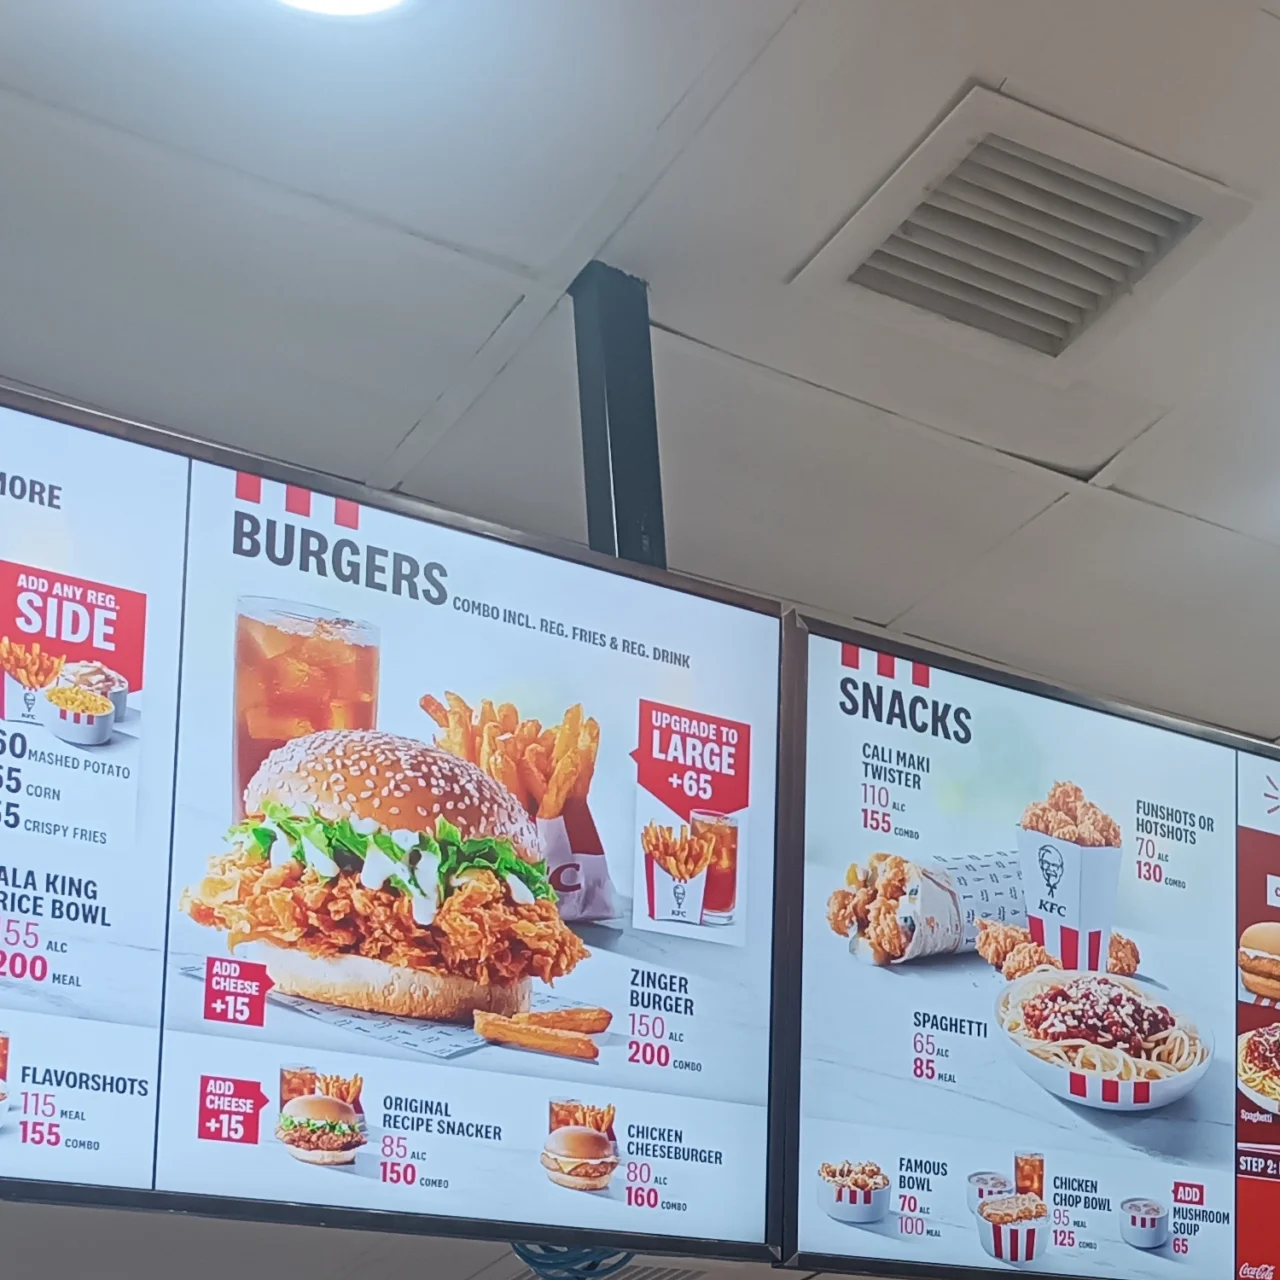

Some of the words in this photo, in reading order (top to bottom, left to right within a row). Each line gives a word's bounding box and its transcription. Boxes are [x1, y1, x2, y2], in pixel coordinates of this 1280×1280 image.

[17, 574, 49, 593] ADD
[52, 581, 83, 601] ANY
[87, 591, 120, 611] REG.
[232, 510, 449, 606] BURGERS
[453, 596, 500, 620] COMBO
[503, 608, 536, 630] INCL.
[540, 618, 569, 638] REG.
[572, 626, 606, 648] FRIES
[609, 636, 619, 651] &
[622, 639, 650, 659] REG.
[653, 647, 691, 669] DRINK
[15, 591, 116, 652] SIDE
[839, 676, 972, 744] SNACKS
[652, 709, 717, 740] UPGRADE
[720, 726, 738, 745] TO
[28, 748, 80, 770] MASHED
[84, 759, 131, 779] POTATO
[652, 729, 736, 776] LARGE
[862, 742, 892, 764] CALI
[896, 749, 930, 773] MAKI
[668, 770, 712, 800] +65
[862, 761, 921, 790] TWISTER
[26, 784, 61, 801] CORN
[861, 783, 889, 808] 110
[892, 801, 906, 812] ALC
[861, 808, 891, 833] 155
[894, 827, 919, 840] COMBO
[1136, 799, 1196, 828] FUNSHOTS
[1199, 815, 1214, 833] OR
[24, 819, 69, 837] CRISPY
[73, 827, 107, 844] FRIES
[1136, 817, 1196, 845] HOTSHOTS
[1136, 836, 1155, 859] 70
[1158, 852, 1169, 863] ALC
[45, 873, 98, 900] KING
[1136, 860, 1162, 883] 130
[1165, 876, 1186, 889] COMBO
[0, 890, 44, 917] RICE
[51, 899, 111, 927] BOWL
[1038, 898, 1067, 918] KFC
[46, 941, 68, 953] ALC
[52, 973, 82, 987] MEAL
[212, 961, 240, 977] ADD
[630, 968, 689, 994] ZINGER
[211, 976, 260, 995] CHEESE
[211, 996, 250, 1021] +15
[629, 989, 694, 1016] BURGER
[628, 1012, 665, 1039] 150
[669, 1031, 684, 1043] ALC
[913, 1011, 988, 1038] SPAGHETTI
[628, 1040, 670, 1067] 200
[673, 1059, 702, 1072] COMBO
[913, 1032, 935, 1056] 65
[936, 1047, 949, 1058] ALC
[21, 1066, 149, 1097] FLAVORSHOTS
[913, 1057, 935, 1080] 85
[938, 1072, 956, 1083] MEAL
[206, 1079, 234, 1094] ADD
[21, 1091, 56, 1118] 115
[60, 1109, 86, 1121] MEAL
[205, 1095, 254, 1113] CHEESE
[383, 1095, 452, 1117] ORIGINAL
[1241, 1109, 1272, 1123] Spaghetti
[19, 1120, 61, 1147] 155
[65, 1138, 100, 1151] COMBO
[205, 1114, 244, 1139] +15
[382, 1114, 433, 1133] RECIPE
[437, 1119, 502, 1141] SNACKER
[627, 1124, 683, 1144] CHICKEN
[381, 1135, 407, 1159] 85
[410, 1151, 427, 1161] ALC
[627, 1141, 723, 1165] CHEESEBURGER
[380, 1162, 416, 1185] 150
[419, 1177, 449, 1189] COMBO
[627, 1161, 651, 1183] 80
[654, 1175, 668, 1186] ALC
[899, 1157, 948, 1177] FAMOUS
[1239, 1156, 1265, 1172] STEP
[899, 1175, 932, 1192] BOWL
[1053, 1176, 1098, 1194] CHICKEN
[1177, 1186, 1200, 1202] ADD
[626, 1186, 658, 1208] 160
[661, 1201, 687, 1212] COMBO
[899, 1194, 917, 1213] 70
[1053, 1192, 1082, 1208] CHOP
[1083, 1195, 1112, 1212] BOWL
[899, 1216, 924, 1235] 100
[1053, 1208, 1070, 1226] 95
[1173, 1207, 1230, 1225] MUSHROOM
[1053, 1229, 1075, 1247] 125
[1173, 1222, 1200, 1237] SOUP
[1173, 1238, 1188, 1254] 65
